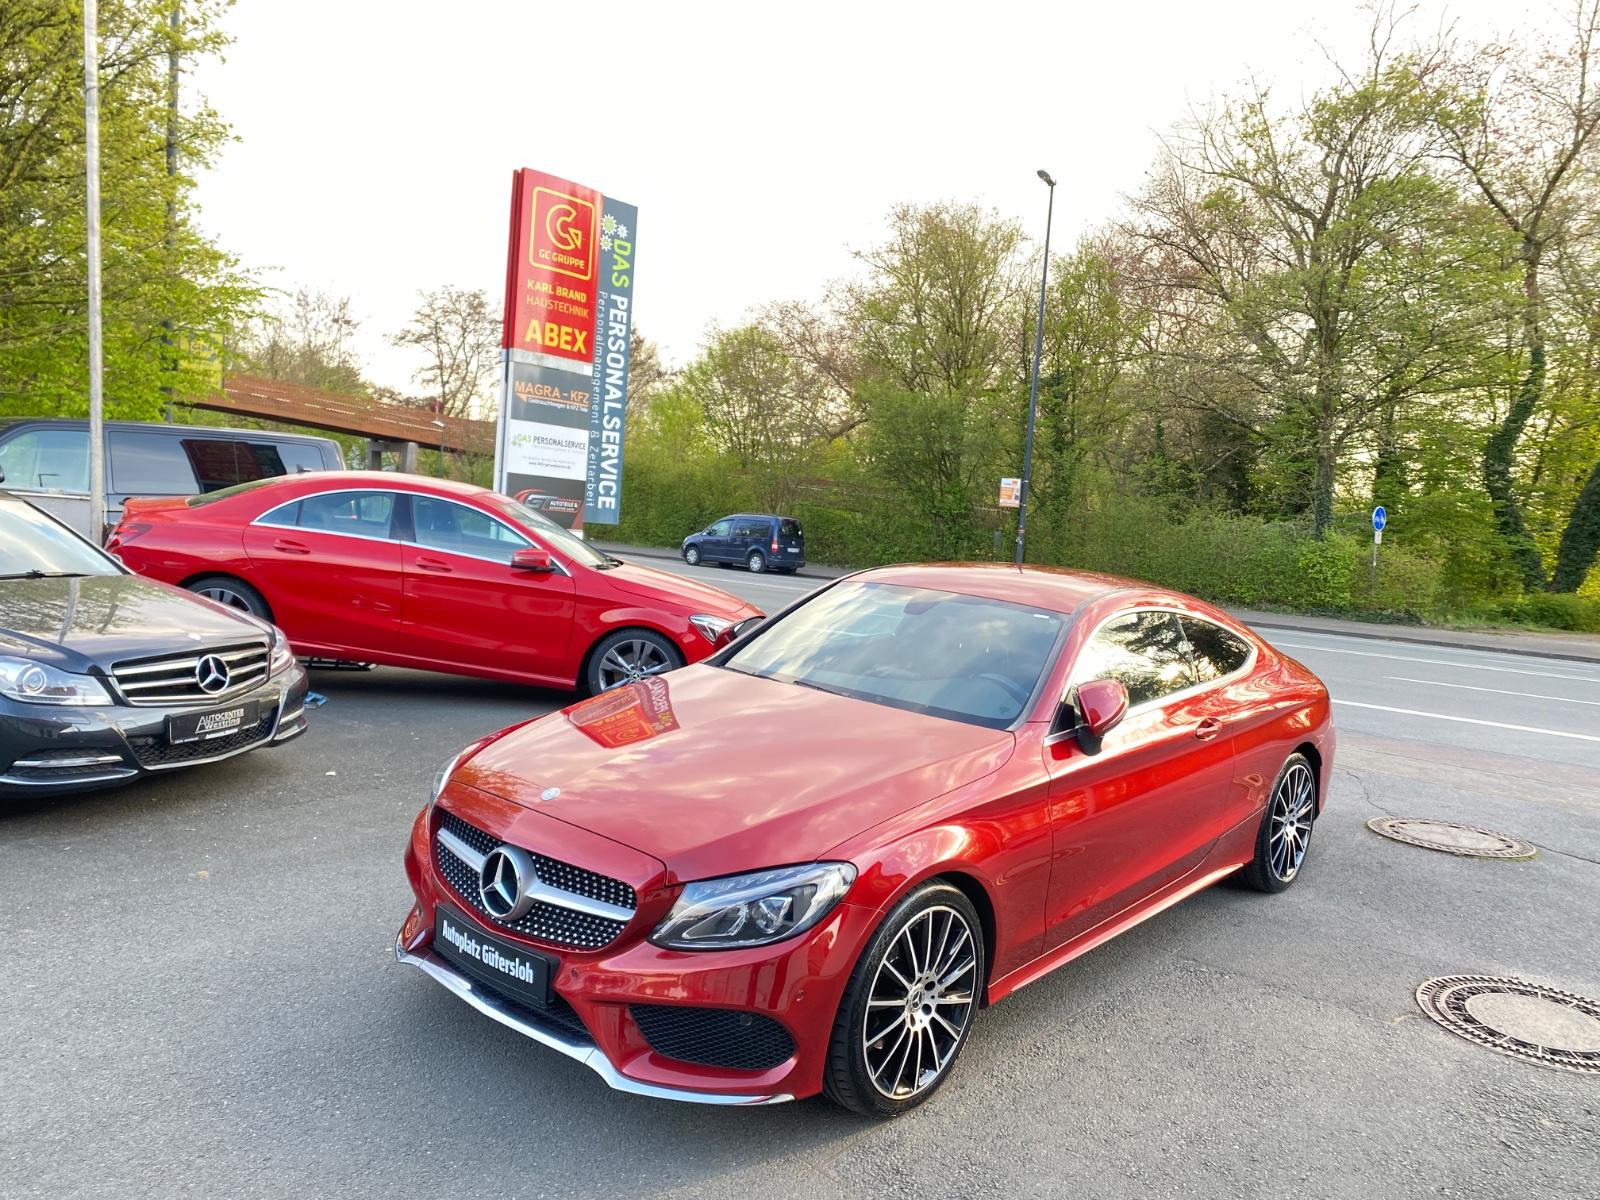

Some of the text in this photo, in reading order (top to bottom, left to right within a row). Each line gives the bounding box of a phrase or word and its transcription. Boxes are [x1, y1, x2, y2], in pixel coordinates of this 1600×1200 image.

[538, 248, 585, 269] GC GRUPPE
[527, 279, 587, 303] KARL BRAND
[526, 295, 589, 318] HAUSTECHNIK
[524, 319, 588, 354] ABEX
[597, 238, 632, 510] DAS PERSONALSERVICE
[514, 381, 560, 399] MAGRA
[570, 390, 590, 404] KFZ
[586, 290, 608, 507] Personalmanagement & Zeitarbeit
[533, 435, 586, 450] PERSONALSERVICE
[442, 919, 533, 984] Autoplatz Gütersloh
